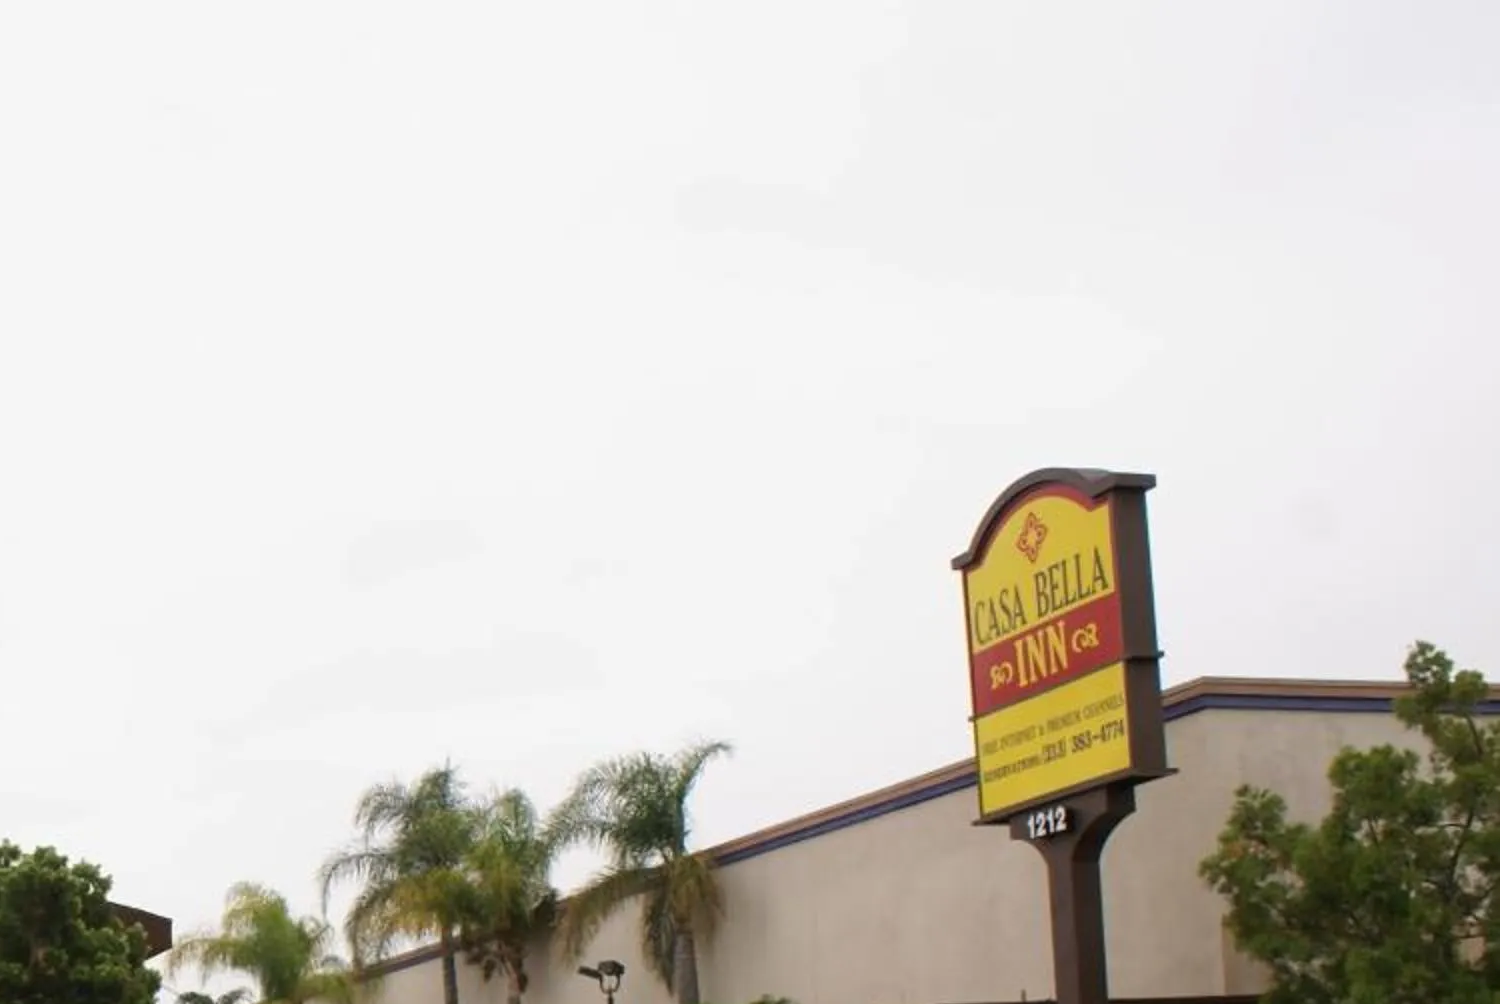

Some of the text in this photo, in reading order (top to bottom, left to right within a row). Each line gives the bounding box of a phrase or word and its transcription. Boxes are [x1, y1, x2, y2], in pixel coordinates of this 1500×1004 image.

[974, 545, 1108, 645] CASA BELLA
[1013, 620, 1069, 688] INN
[1028, 805, 1067, 839] 1212
